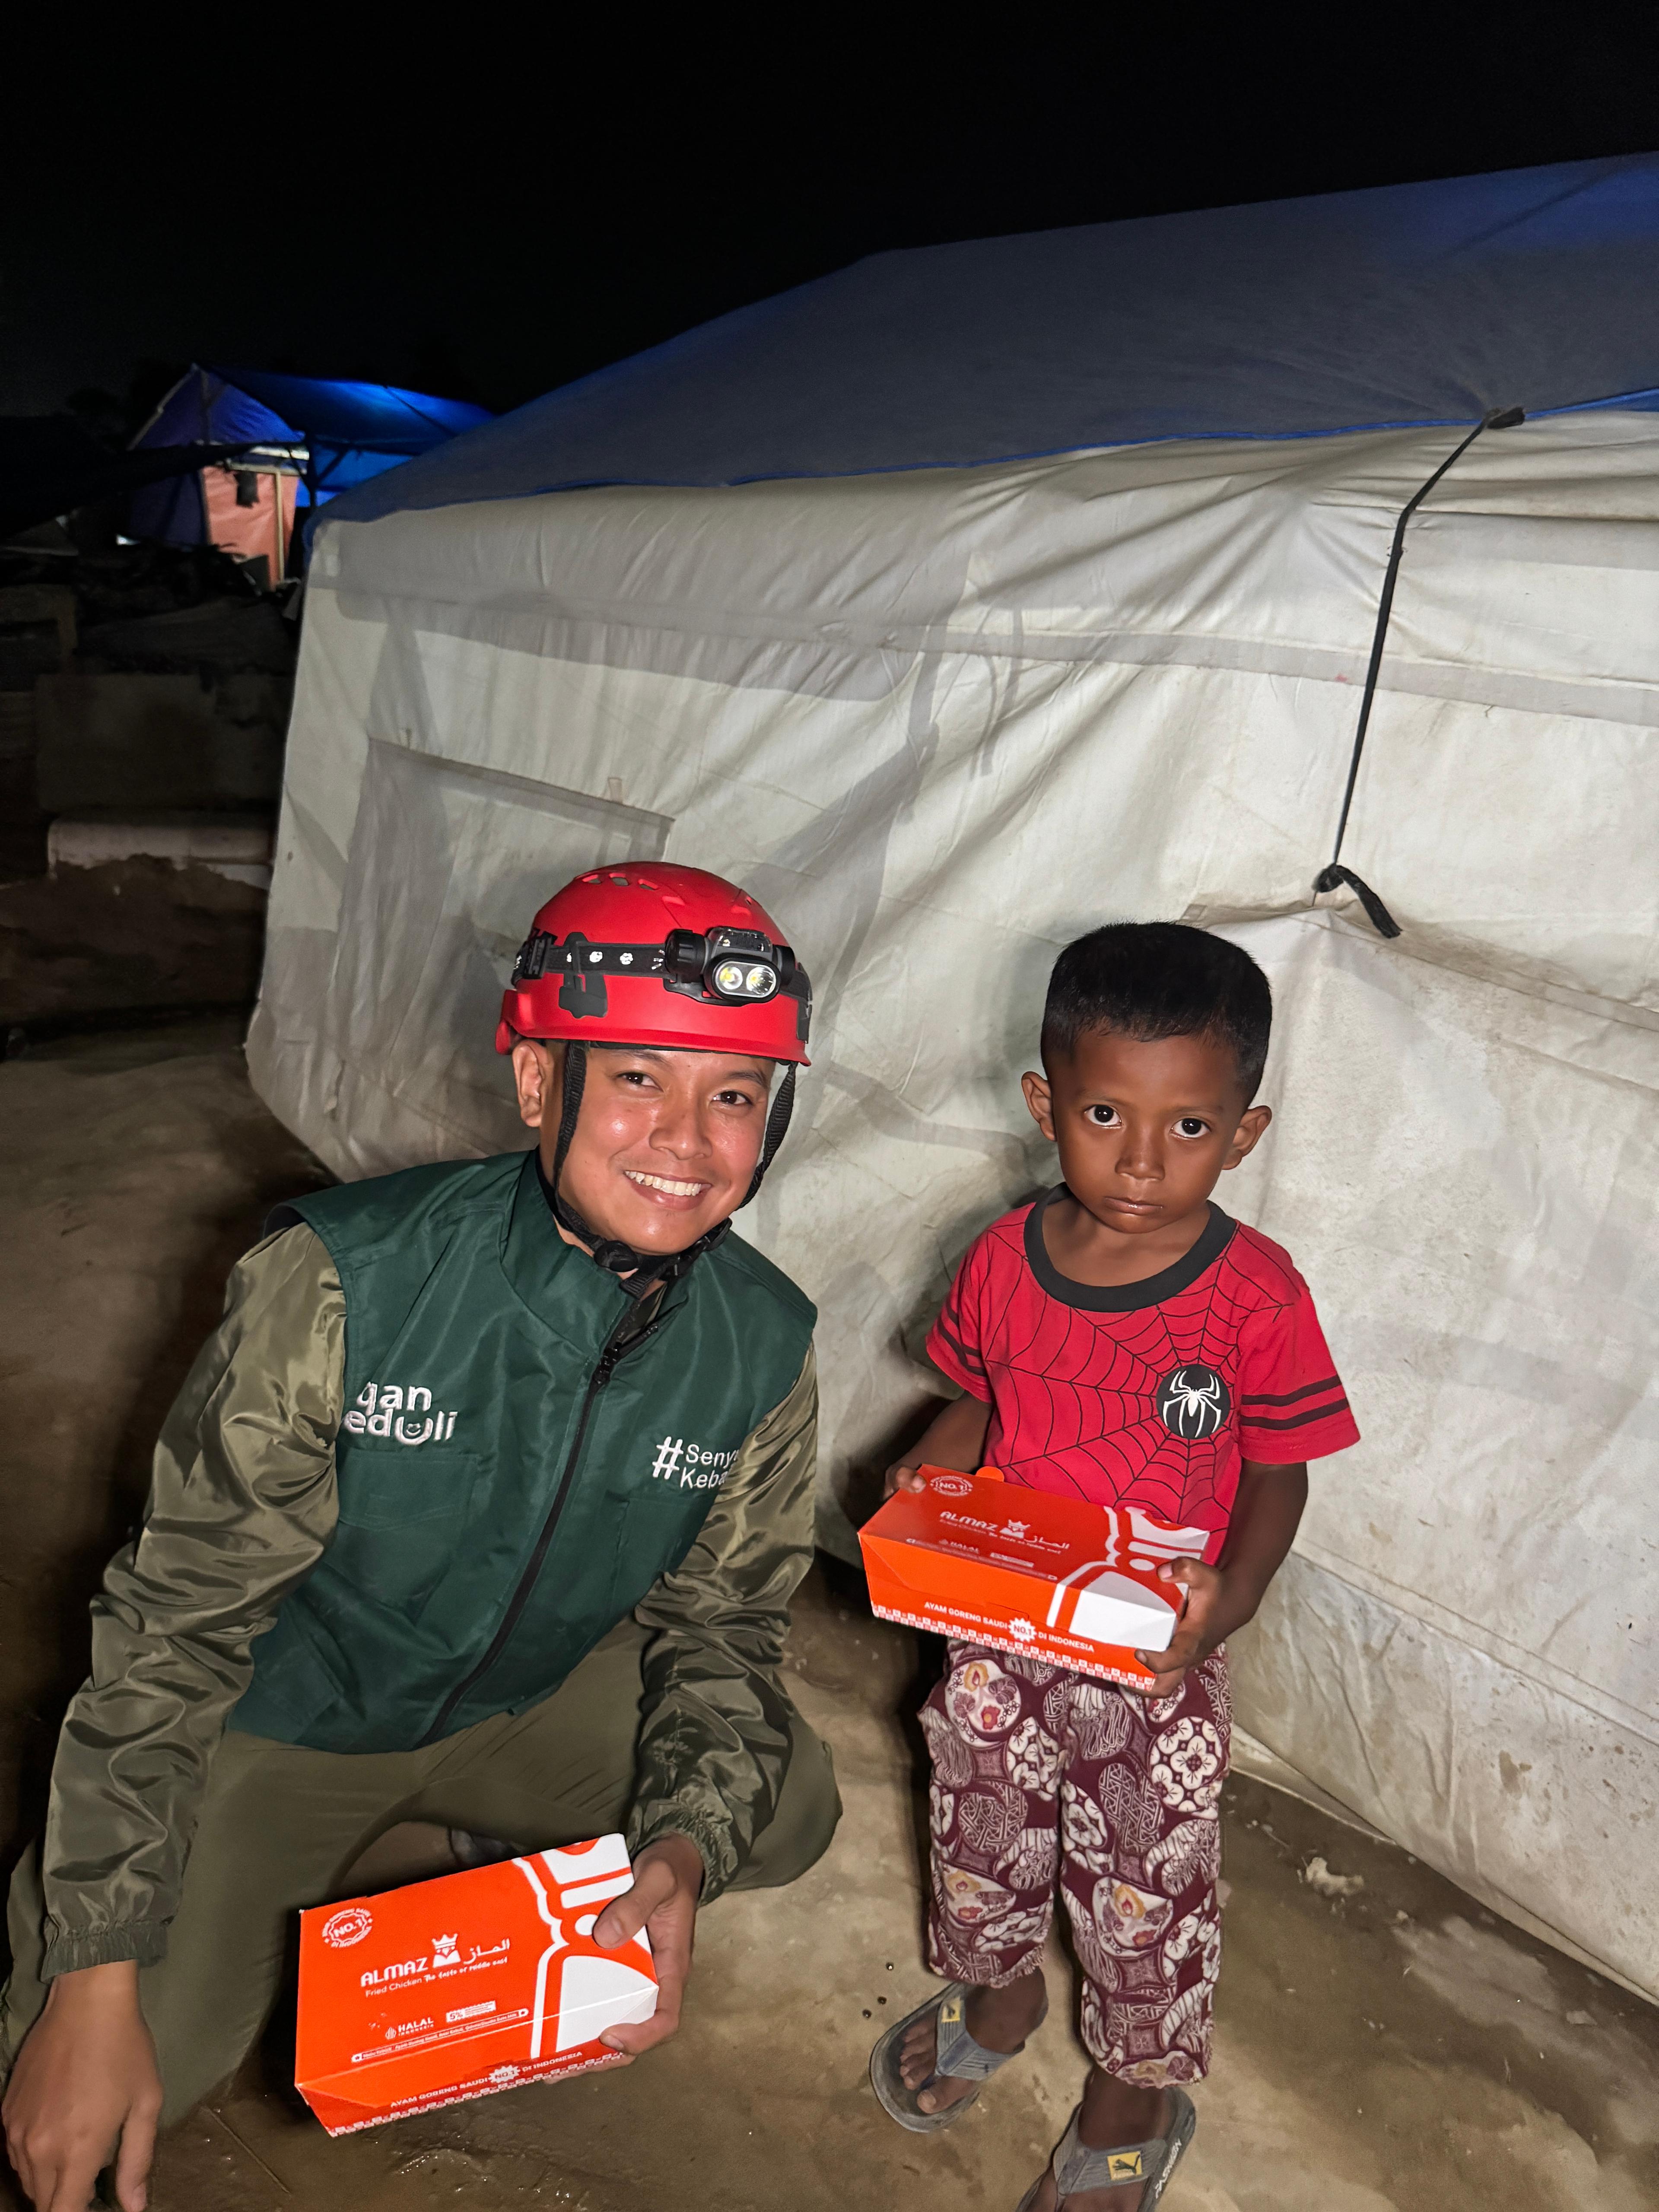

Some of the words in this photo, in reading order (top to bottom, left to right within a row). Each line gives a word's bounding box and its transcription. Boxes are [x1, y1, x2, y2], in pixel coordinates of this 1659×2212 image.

[940, 1511, 998, 1531] ALMAZ
[924, 1602, 947, 1614] AYAM
[948, 1608, 981, 1622] GORENG
[983, 1617, 1007, 1629] SAUDI
[1014, 1625, 1032, 1636] NO.1
[1038, 1631, 1047, 1640] DI
[1049, 1634, 1094, 1653] INDONESIA
[334, 1918, 362, 1937] NO.1
[361, 1957, 428, 1987] ALMAZ
[365, 1986, 387, 1998] Fried
[389, 1978, 422, 1990] Chicken
[423, 1974, 436, 1983] The
[493, 1956, 508, 1965] east
[398, 2017, 434, 2032] HALAL
[391, 2096, 417, 2107] AYAM
[460, 2077, 488, 2088] SAUDI
[533, 2052, 582, 2069] INDONESIA
